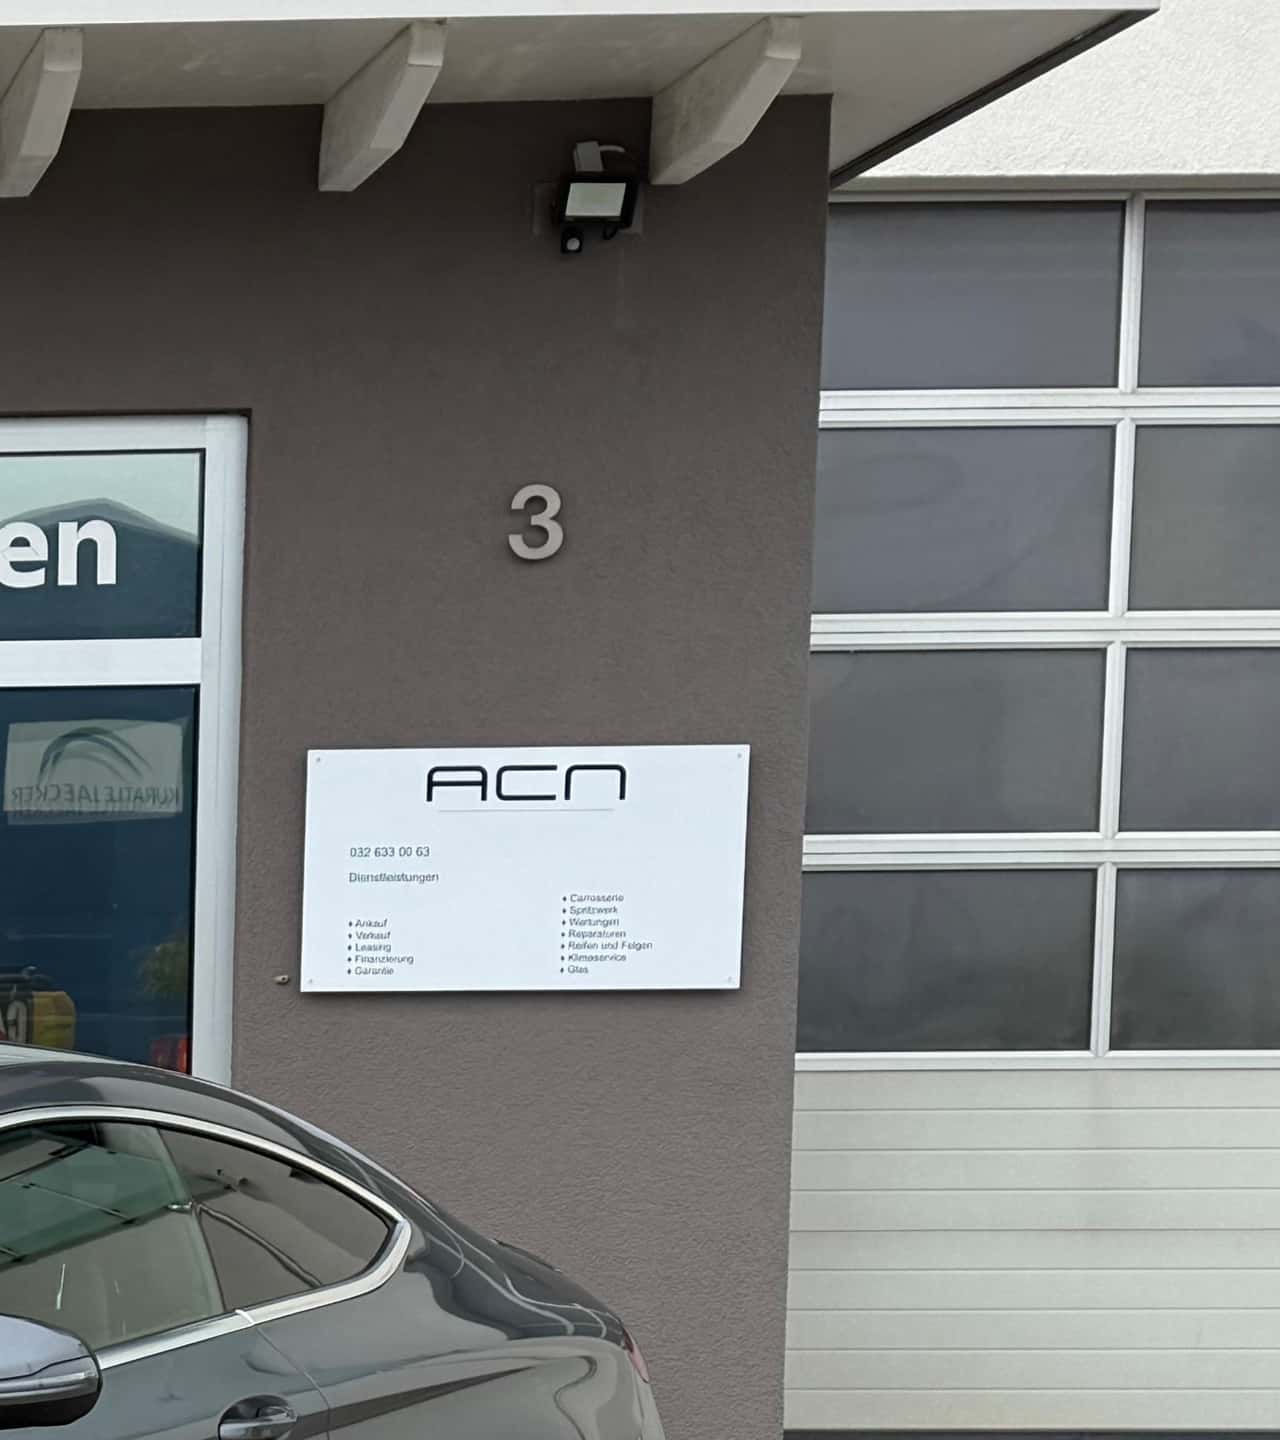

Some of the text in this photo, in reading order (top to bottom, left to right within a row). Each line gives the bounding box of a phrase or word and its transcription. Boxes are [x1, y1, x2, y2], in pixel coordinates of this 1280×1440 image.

[508, 483, 564, 560] 3
[426, 764, 627, 802] ACN
[350, 846, 430, 857] 032 633 00 63
[348, 872, 439, 884] Dienstleistungen
[570, 893, 624, 903] Carrosserie
[569, 905, 618, 916] Spritzwerk
[355, 918, 388, 928] Ankauf
[569, 918, 620, 928] Wartungen
[355, 931, 391, 940] Verkauf
[568, 929, 626, 939] Reparaturen
[355, 943, 392, 953] Leasing
[568, 941, 599, 950] Reifen
[354, 955, 414, 965] Finanzierung
[568, 953, 627, 962] Klimaservice
[354, 966, 394, 976] Garantie
[567, 965, 589, 974] Glas
